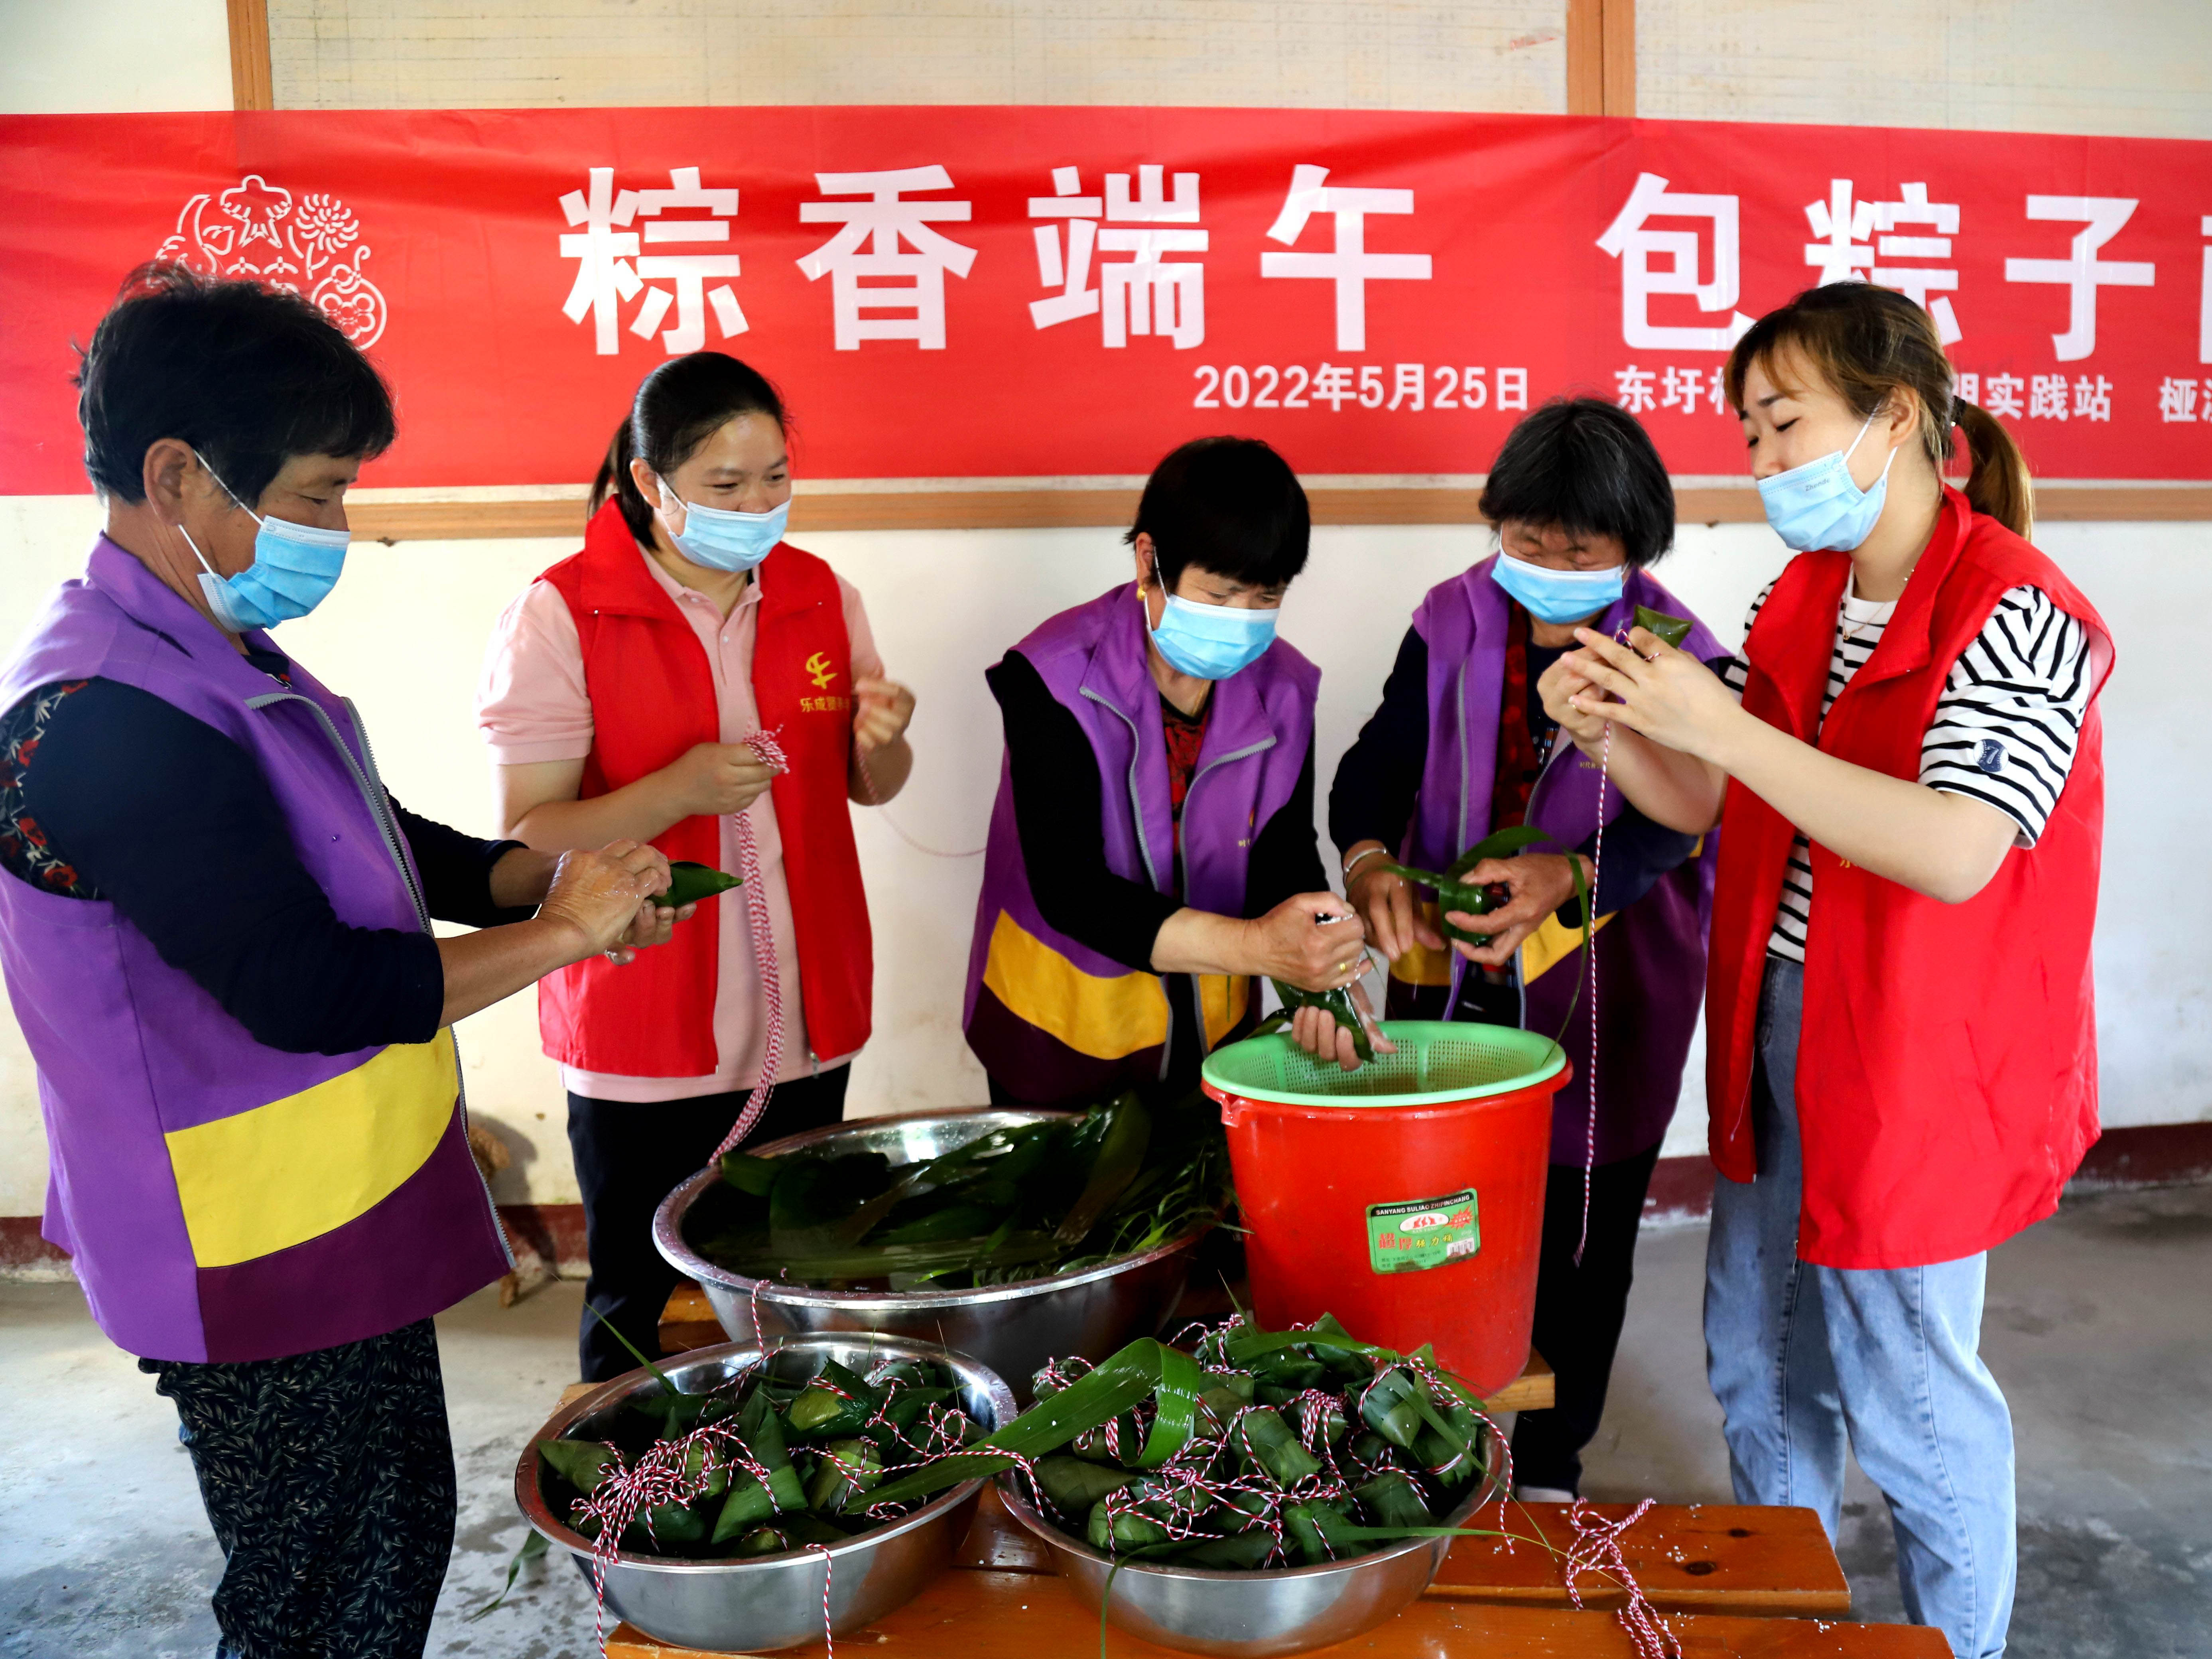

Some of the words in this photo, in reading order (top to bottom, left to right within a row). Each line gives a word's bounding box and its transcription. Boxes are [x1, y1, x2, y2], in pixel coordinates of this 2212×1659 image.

[558, 164, 1433, 356] 粽香端午
[1595, 172, 2212, 364] 包粽子
[1194, 362, 1529, 412] 2022年5月25日
[1407, 1204, 1430, 1213] SULIAO
[1430, 1195, 1470, 1209] ZHIPINCHANG
